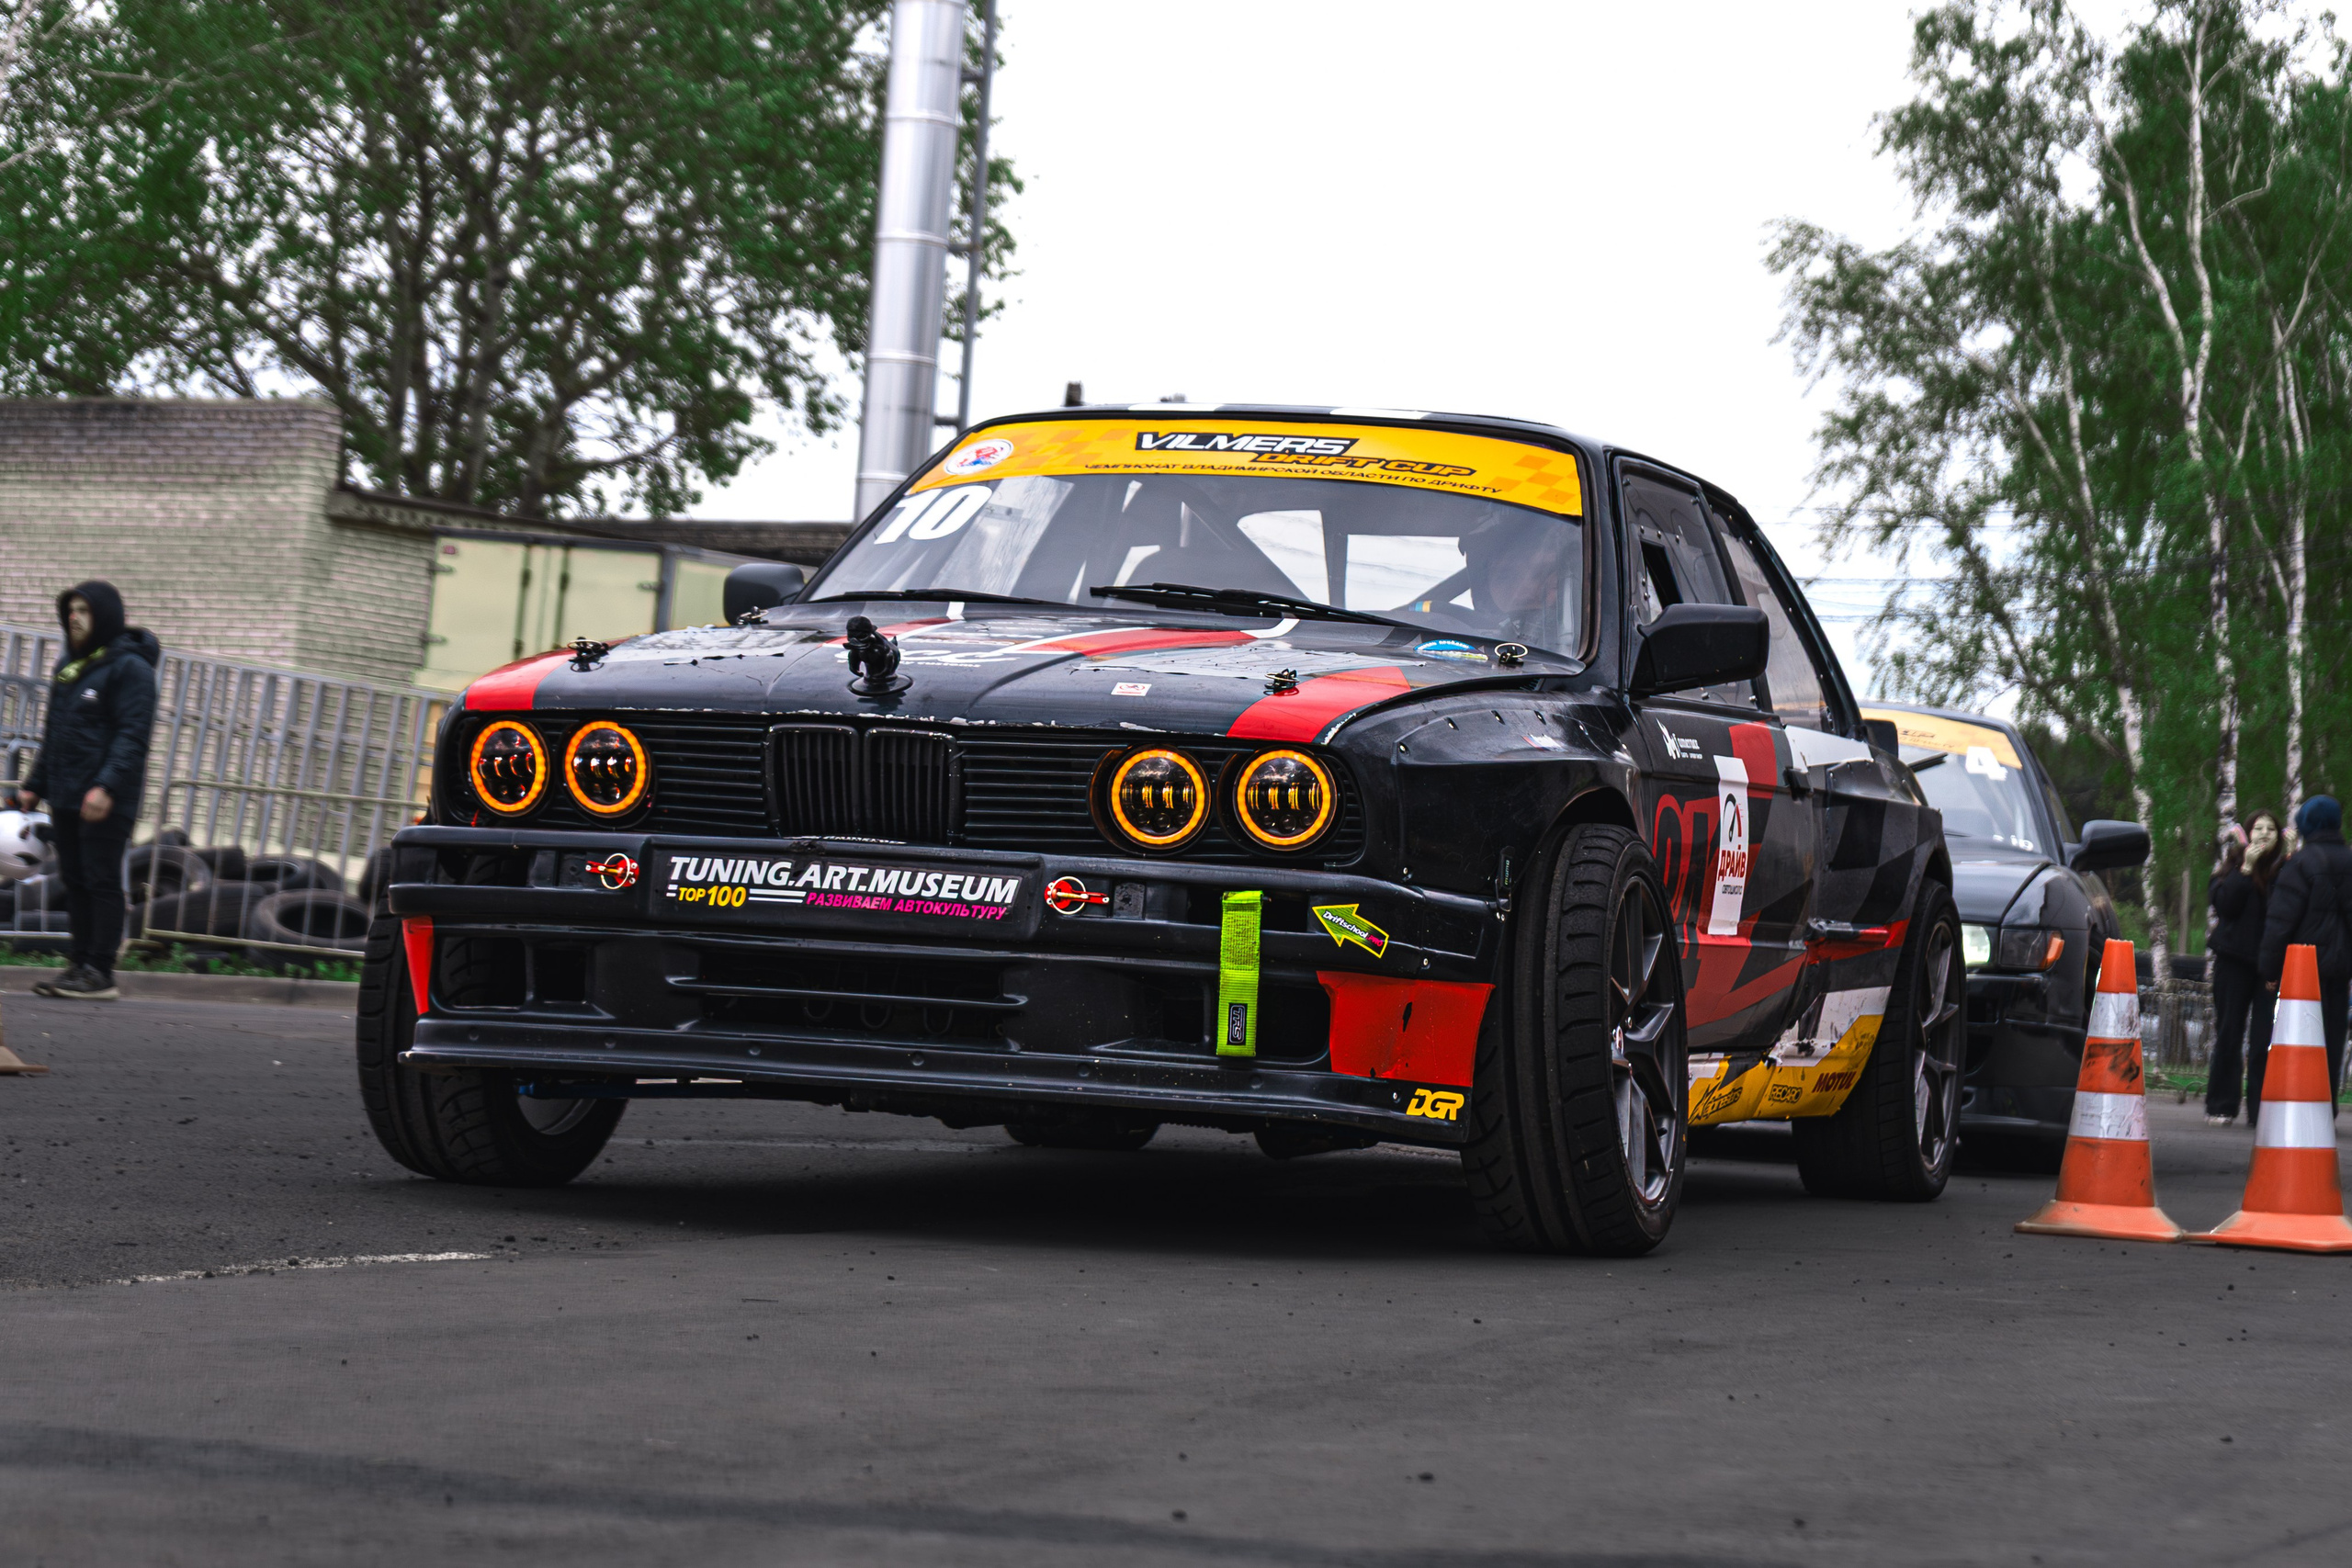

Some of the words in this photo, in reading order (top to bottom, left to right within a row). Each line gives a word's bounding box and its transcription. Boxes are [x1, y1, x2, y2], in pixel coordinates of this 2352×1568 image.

[1139, 433, 1351, 455] VILMERS
[1182, 463, 1318, 476] ВЛАДИМИРСКОЙ
[1319, 468, 1400, 481] ОБЛАСТИ
[1401, 475, 1427, 484] ПО
[1428, 478, 1503, 494] ДРИФТУ
[1254, 451, 1383, 468] DRIFT
[1381, 459, 1475, 477] CUP
[873, 484, 993, 545] 10
[1964, 746, 2008, 781] 4
[1717, 843, 1747, 882] ДРАЙВ
[670, 855, 1020, 904] TUNING.ART.MUSEUM
[678, 886, 707, 902] TOP
[707, 885, 747, 908] 100
[806, 892, 892, 911] РАЗВИВАЕМ
[894, 898, 1008, 920] АВТОКУЛЬТУРУ
[1769, 1084, 1804, 1104] RECARO
[1812, 1071, 1858, 1093] MOTUL
[1406, 1089, 1465, 1121] DGR
